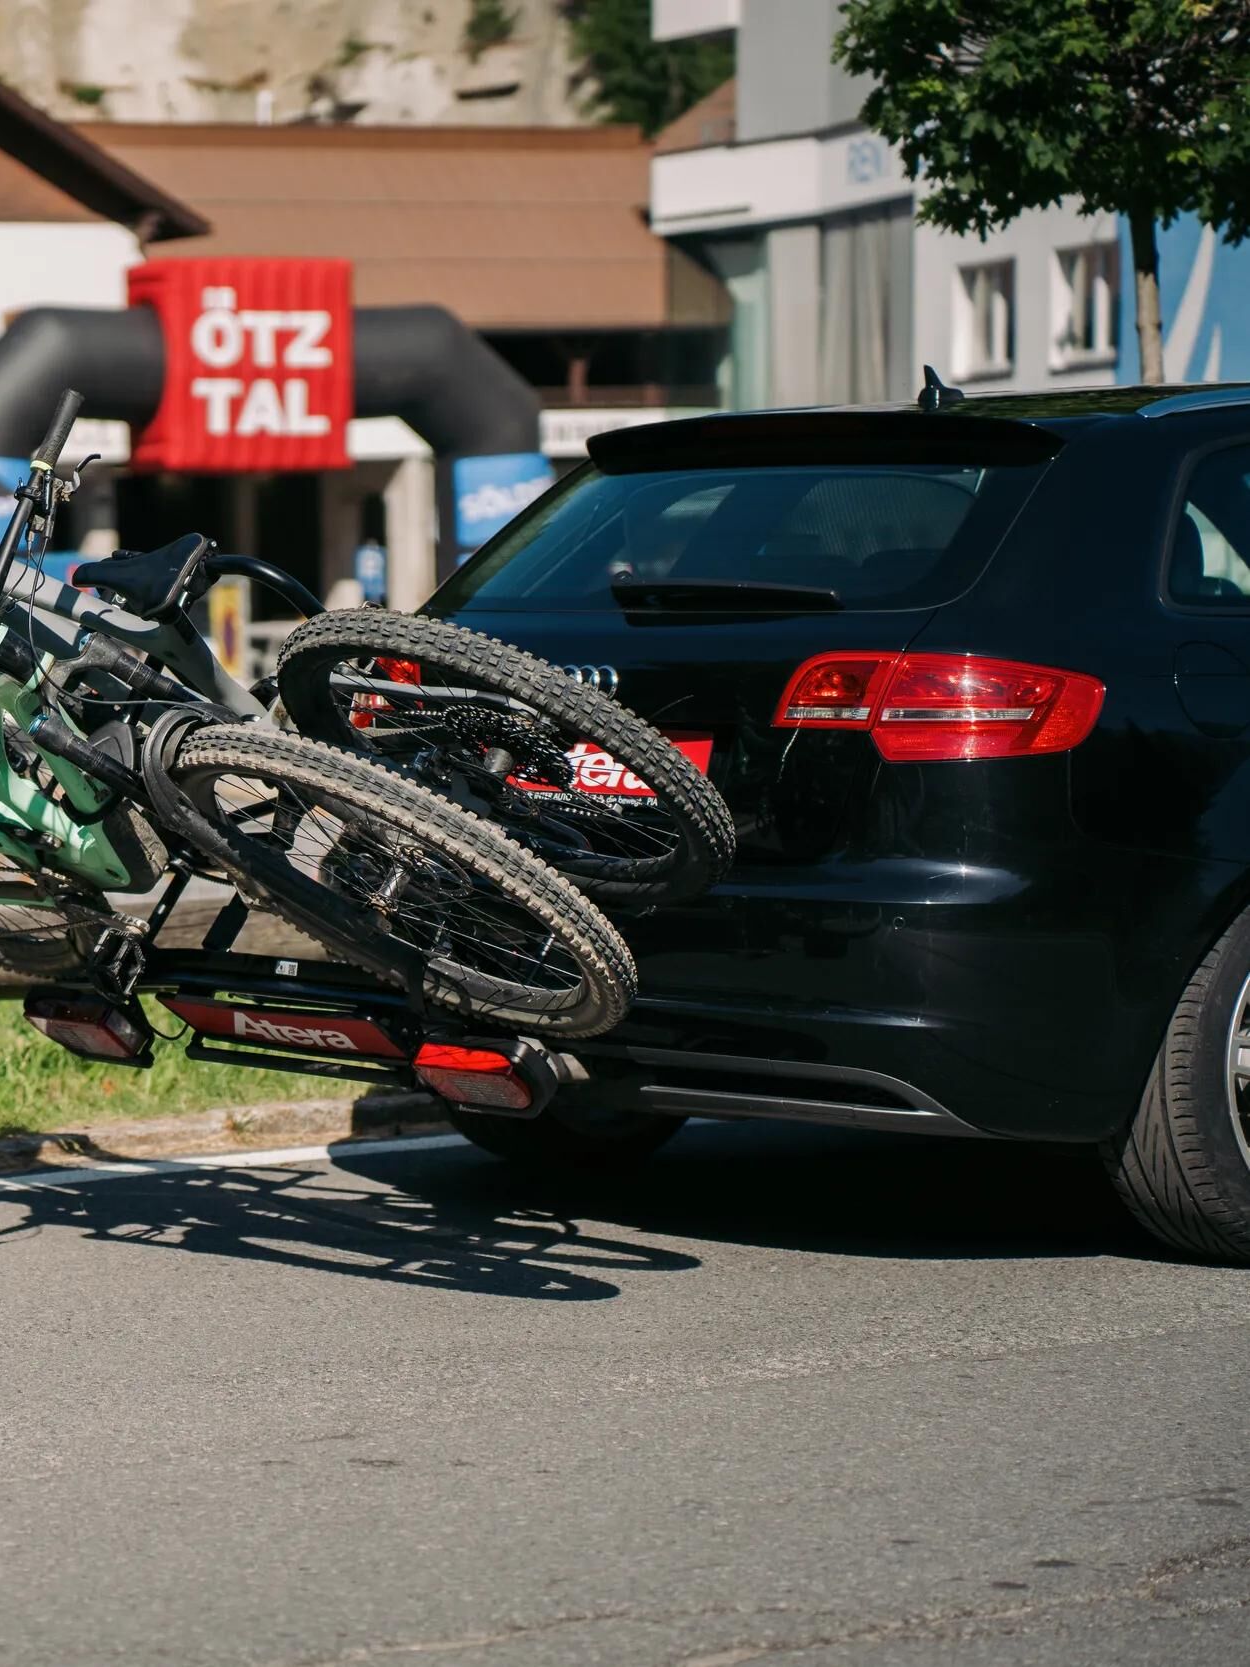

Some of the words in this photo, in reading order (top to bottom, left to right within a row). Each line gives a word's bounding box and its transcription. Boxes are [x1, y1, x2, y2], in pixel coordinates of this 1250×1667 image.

[190, 285, 332, 369] ÖTZ
[190, 377, 331, 436] TAL
[553, 793, 572, 801] AUTO
[233, 1011, 359, 1050] Atera
